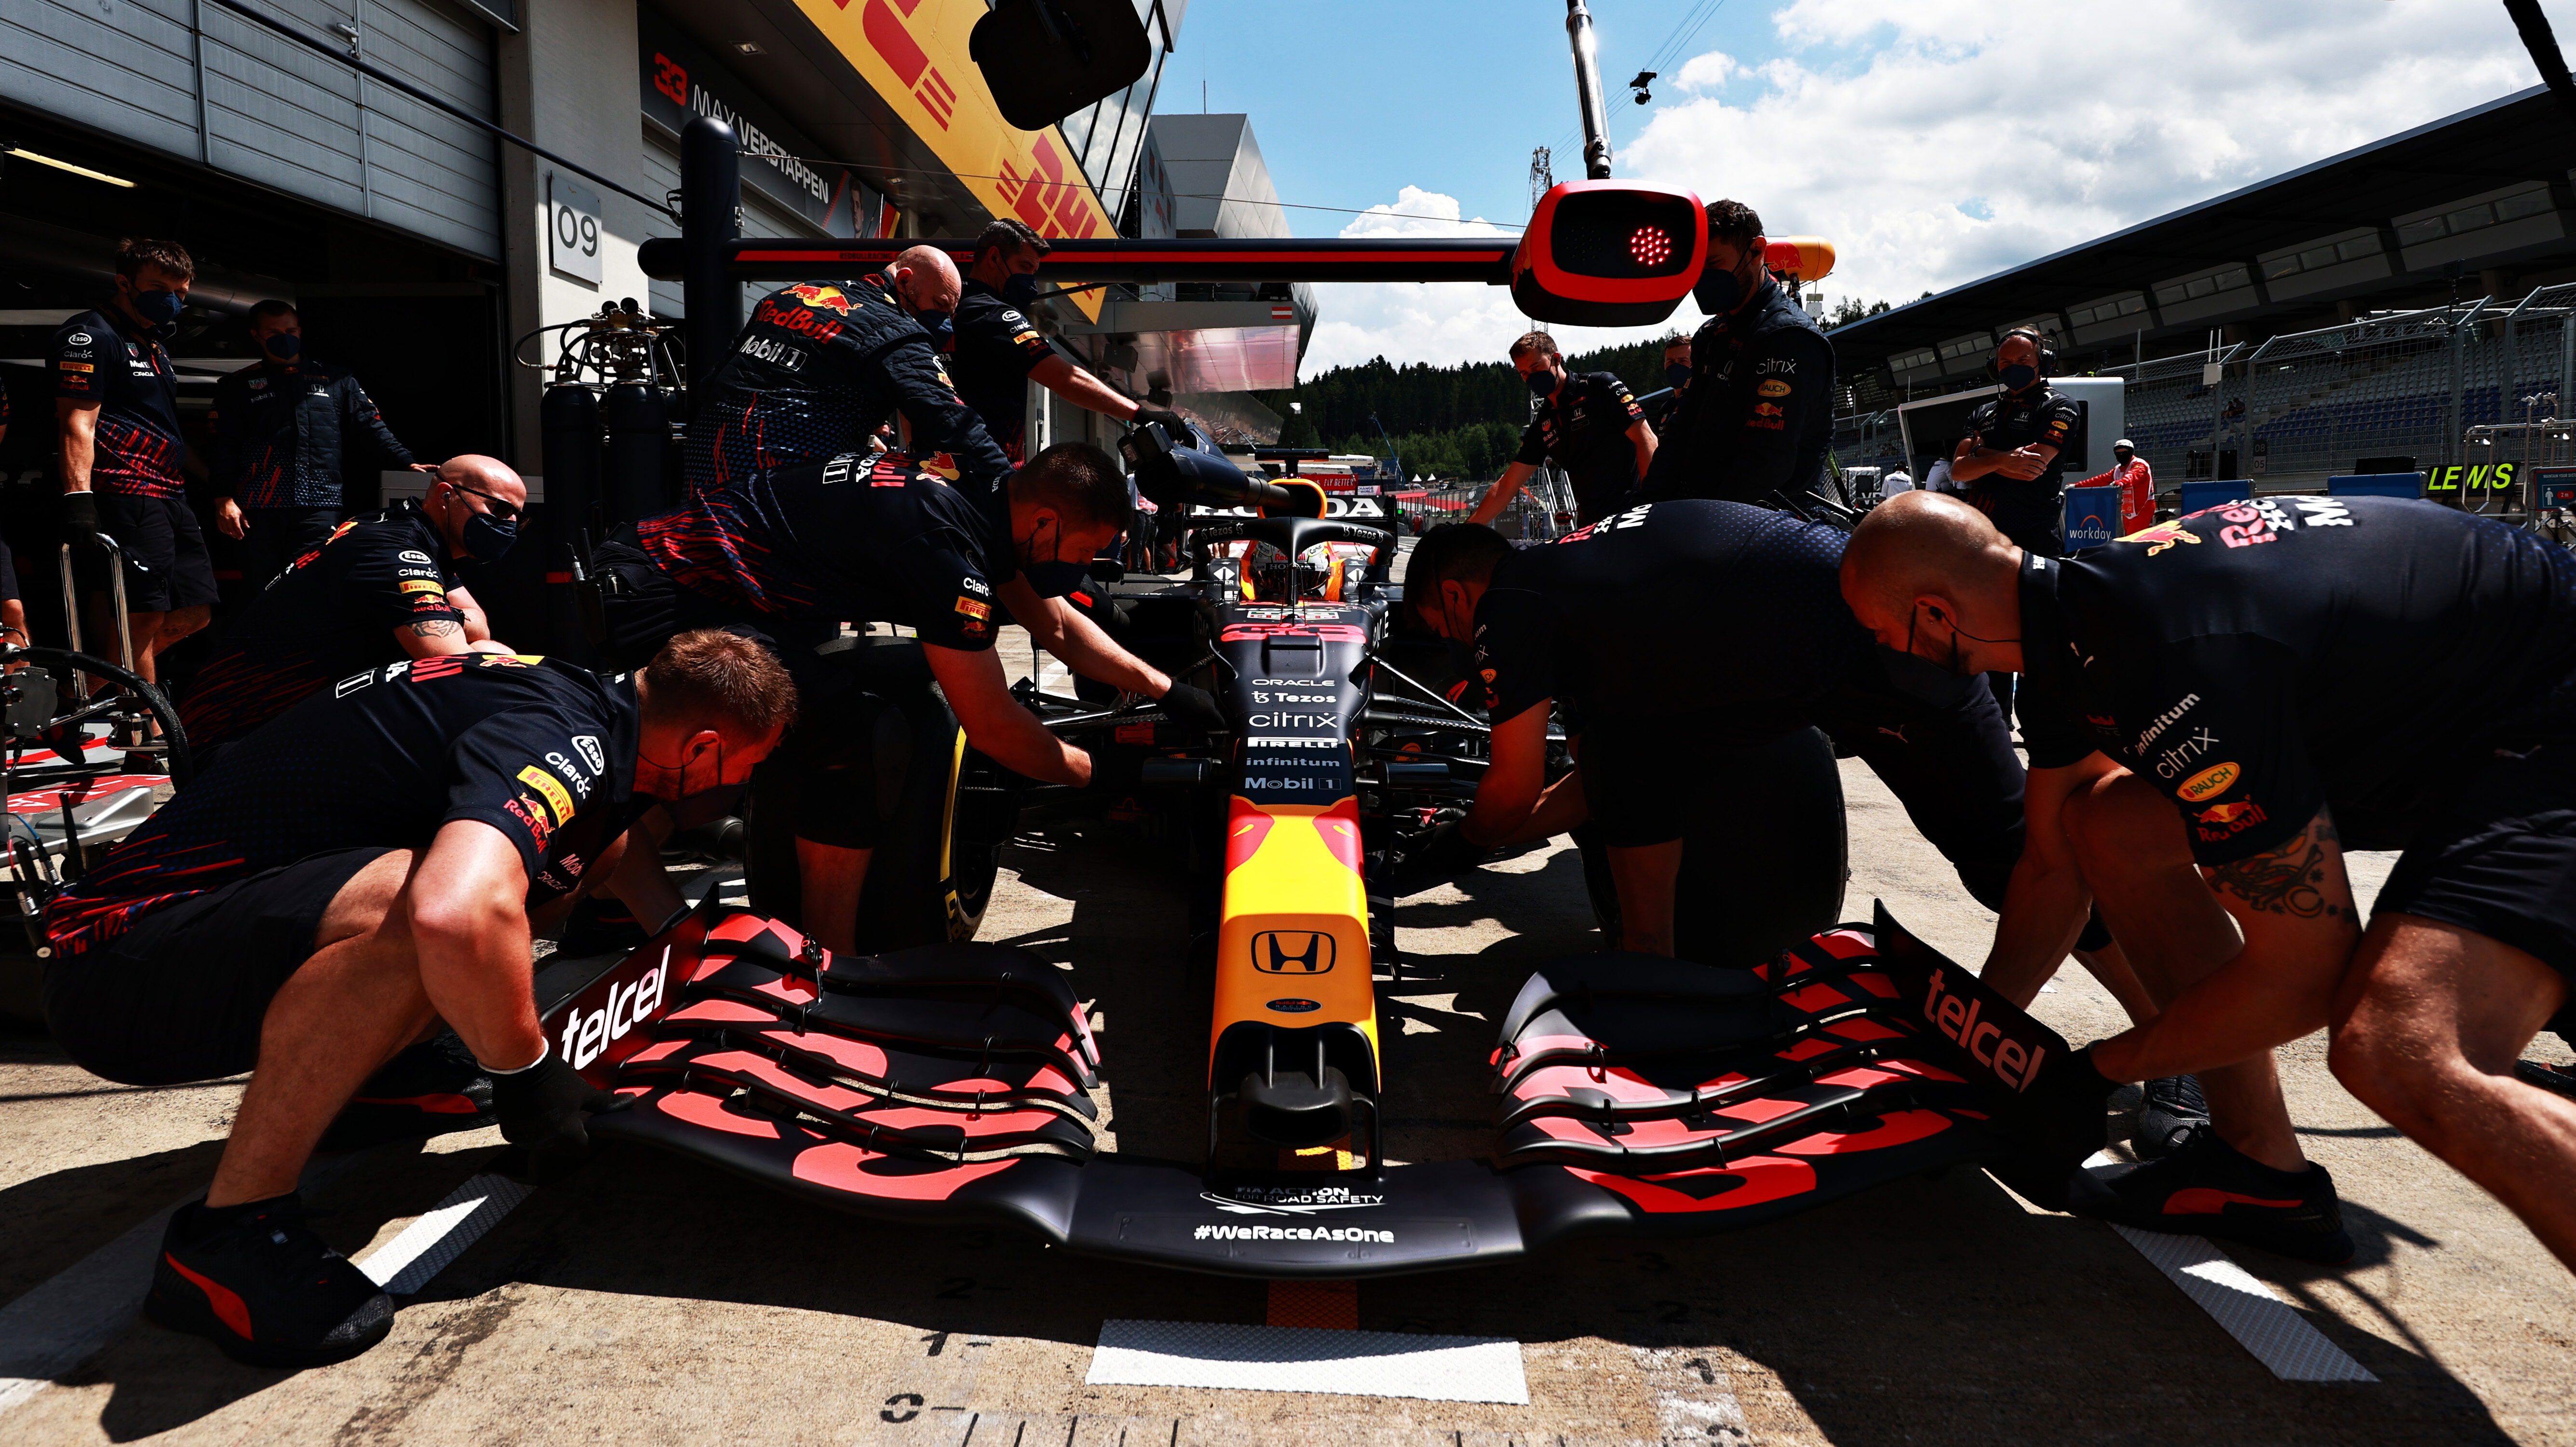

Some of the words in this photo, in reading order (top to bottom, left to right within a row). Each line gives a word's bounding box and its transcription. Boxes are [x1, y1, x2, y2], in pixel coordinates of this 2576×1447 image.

[654, 52, 688, 107] 33
[693, 84, 736, 128] MAX
[738, 116, 830, 204] VERSTAPPEN
[557, 205, 599, 257] 09
[64, 350, 92, 359] Claro
[1756, 358, 1796, 374] citrix
[2055, 413, 2074, 423] citrix
[2254, 442, 2266, 453] 08
[2254, 459, 2266, 470] 05
[2428, 463, 2513, 491] LEWS
[1190, 498, 1384, 517] HODA
[1209, 526, 1233, 536] Tezos
[1351, 526, 1376, 540] Tezos
[2069, 527, 2111, 541] workday
[399, 568, 438, 579] Claro
[1221, 623, 1367, 644] 33
[1275, 692, 1336, 703] Tezos
[1249, 712, 1338, 729] citrix
[2135, 693, 2201, 756] infinitum
[1247, 737, 1338, 748] PIRELLI
[2157, 727, 2219, 779] citrix
[1246, 757, 1340, 767] infinitum
[545, 752, 591, 799] Claro
[1245, 777, 1313, 789] Mobil
[2190, 767, 2233, 796] RAUCH
[526, 771, 570, 820] PIRELLI
[562, 944, 671, 1070] telcel
[1924, 967, 2046, 1093] telcel
[1264, 1194, 1312, 1204] ROAD
[1317, 1195, 1383, 1204] SAFETY
[1269, 1187, 1349, 1196] ACTION
[1194, 1225, 1394, 1244] #WeRaceAsOne
